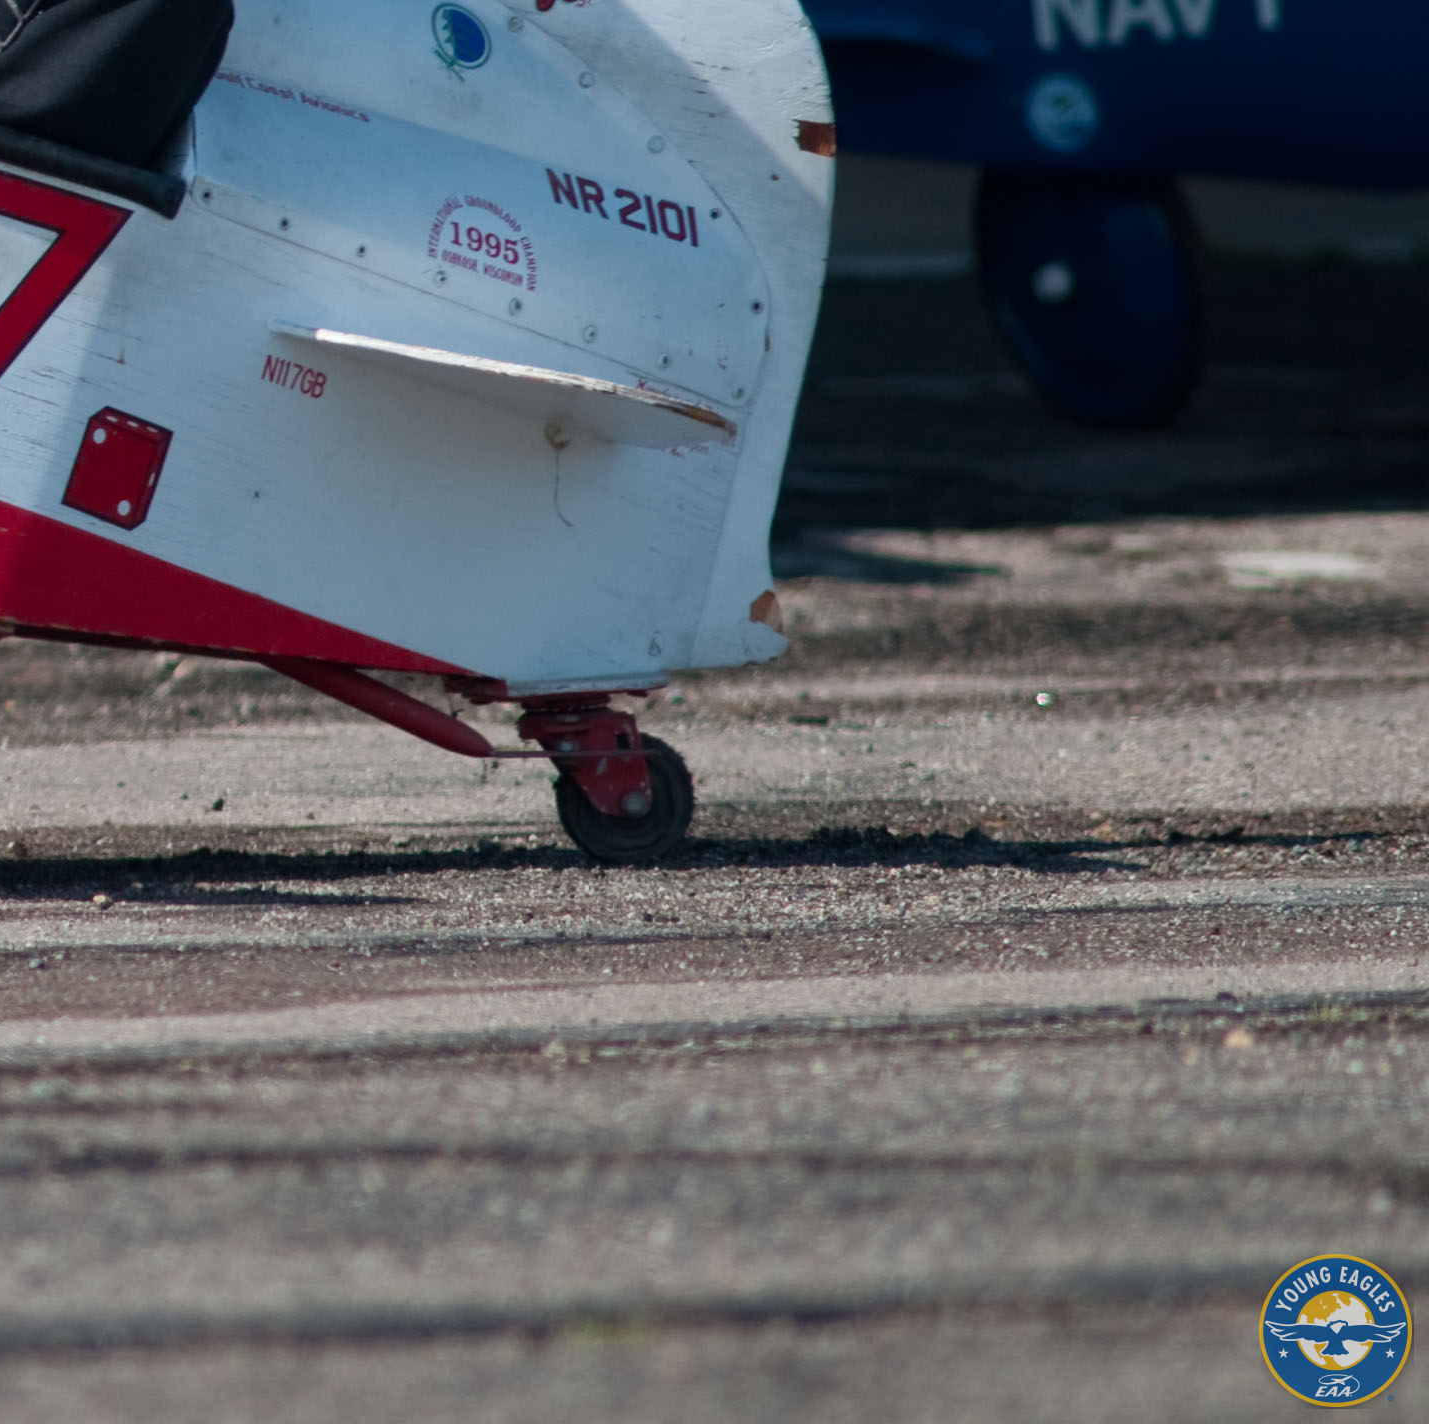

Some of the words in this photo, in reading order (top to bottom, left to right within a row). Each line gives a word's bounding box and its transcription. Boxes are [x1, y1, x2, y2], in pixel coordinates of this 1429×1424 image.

[545, 167, 609, 220] NR
[614, 187, 699, 248] 2101
[449, 220, 520, 266] 1995
[520, 235, 537, 292] CHAMPION
[261, 354, 327, 399] N117GB
